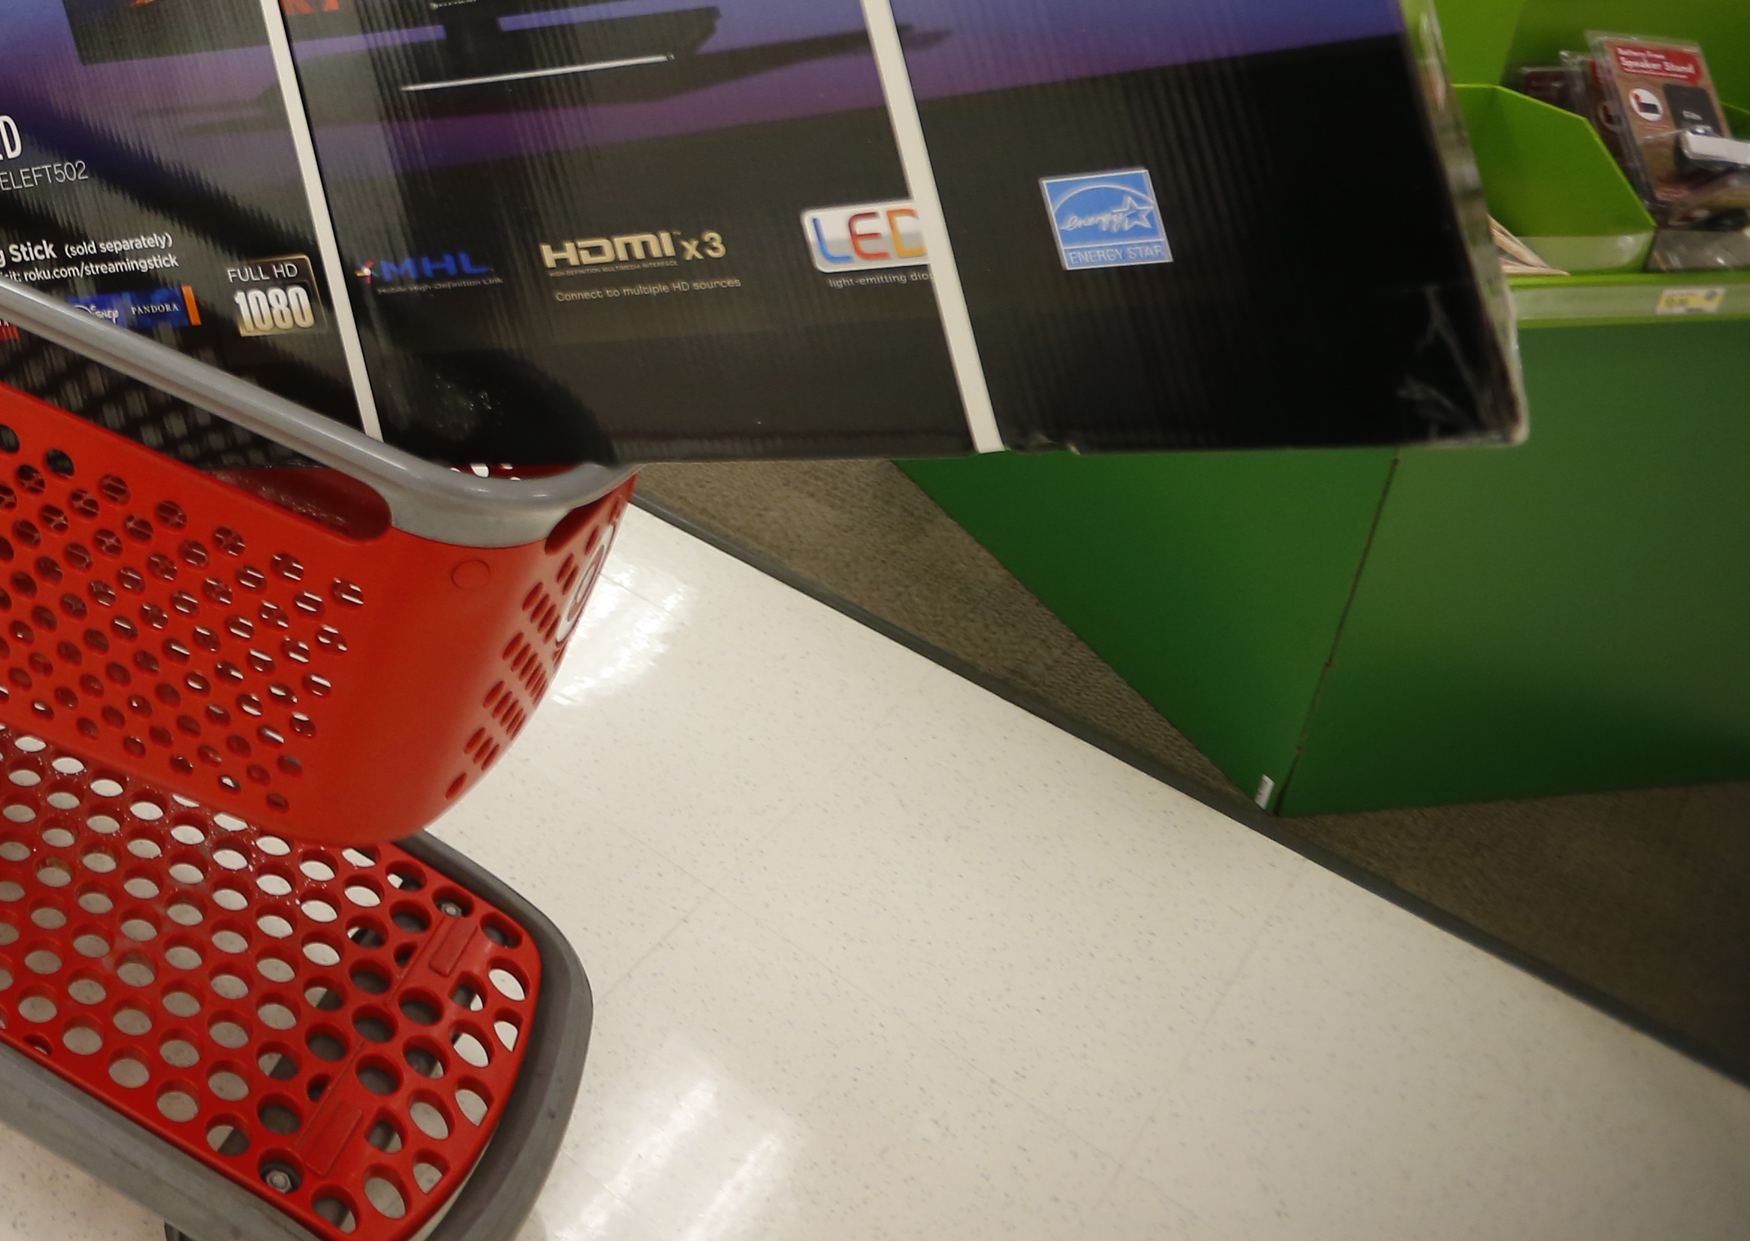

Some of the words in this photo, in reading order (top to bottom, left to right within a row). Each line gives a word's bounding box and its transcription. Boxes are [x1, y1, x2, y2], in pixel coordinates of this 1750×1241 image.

[0, 160, 89, 192] ELEFT502
[8, 240, 57, 264] Stick
[64, 241, 97, 259] (sold
[98, 232, 173, 255] separately)
[812, 208, 928, 263] LED
[24, 253, 179, 283] roku.com/streamingstick
[379, 252, 491, 283] MHL
[1069, 248, 1124, 265] ENERGY
[1126, 244, 1164, 260] STAR
[226, 263, 271, 284] FULL
[273, 263, 299, 279] HD
[829, 273, 908, 289] light-emitting
[555, 290, 604, 302] Connect
[606, 288, 621, 298] to
[623, 283, 670, 297] multiple
[672, 281, 690, 292] HD
[692, 278, 742, 291] sources
[131, 303, 180, 315] PANDORA
[234, 285, 315, 332] 1080
